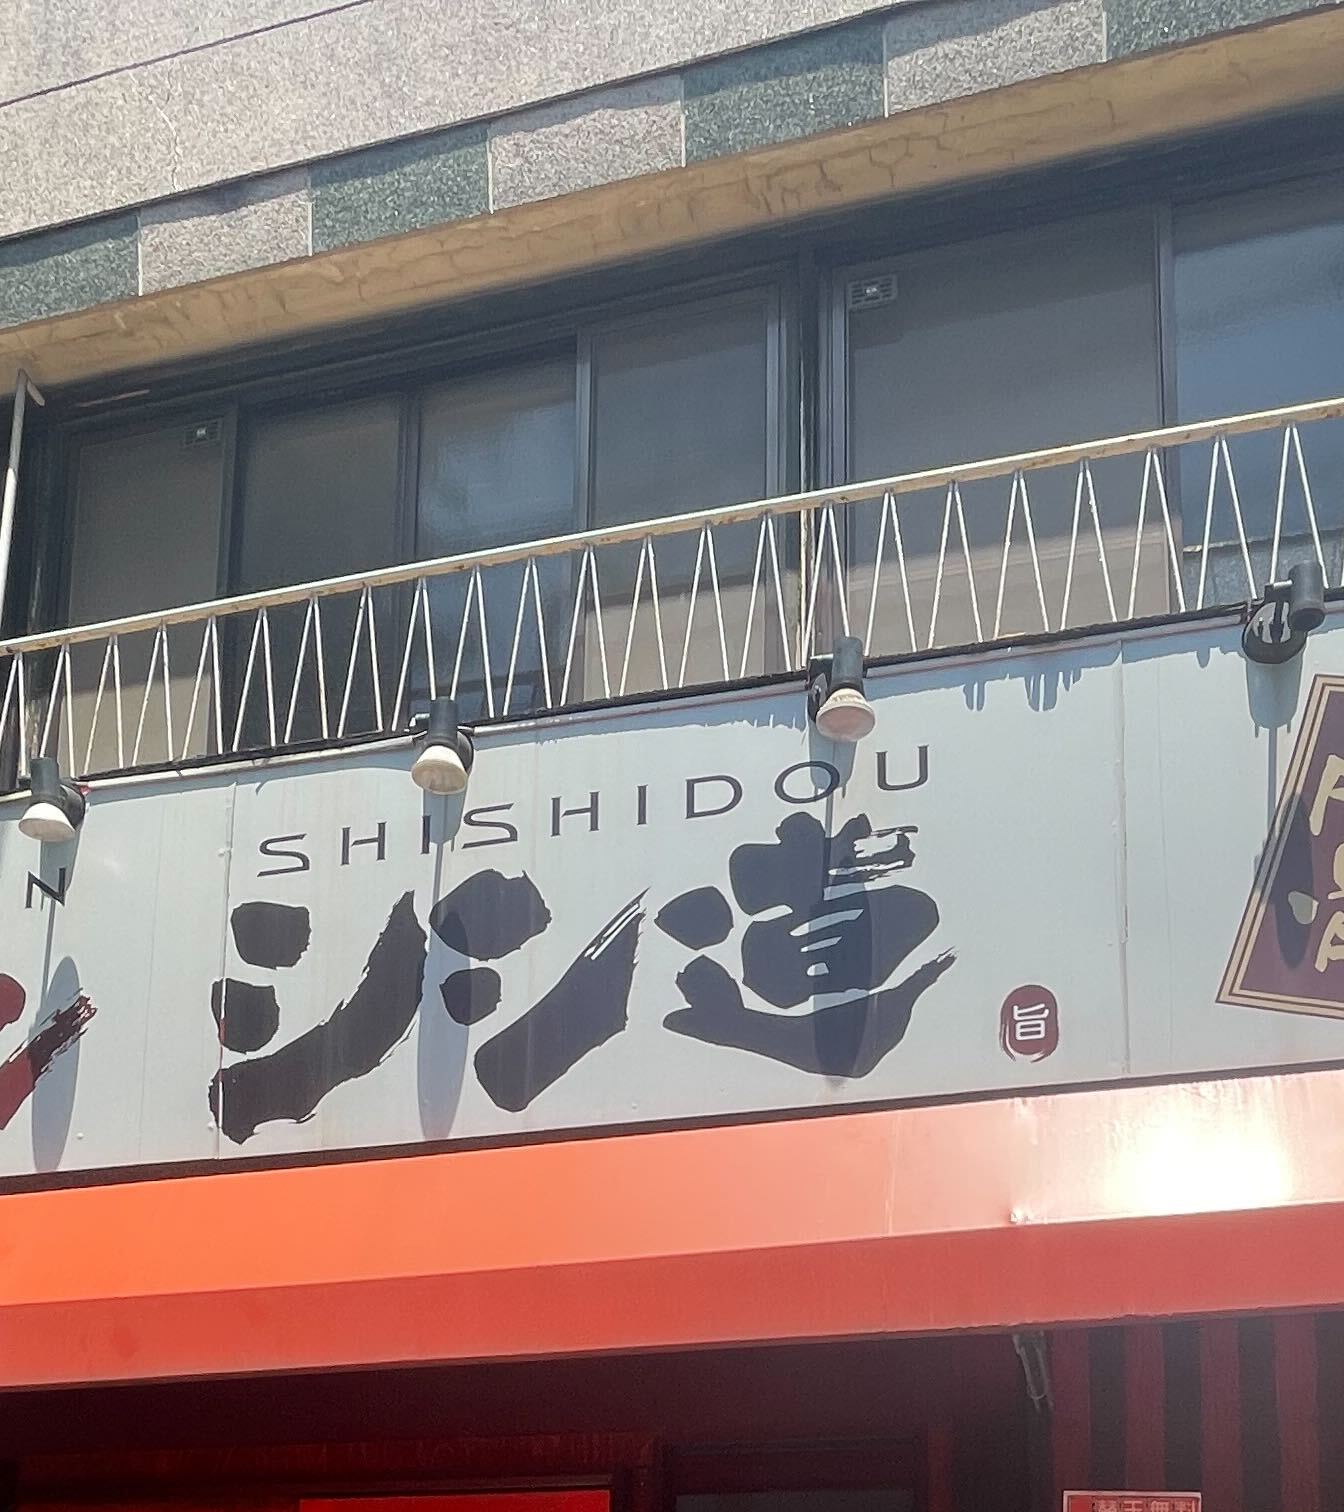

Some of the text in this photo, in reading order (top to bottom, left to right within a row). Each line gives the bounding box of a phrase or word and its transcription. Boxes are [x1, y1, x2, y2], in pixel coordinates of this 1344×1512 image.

[257, 744, 931, 878] SHISHIDOU
[209, 812, 958, 1147] シン道
